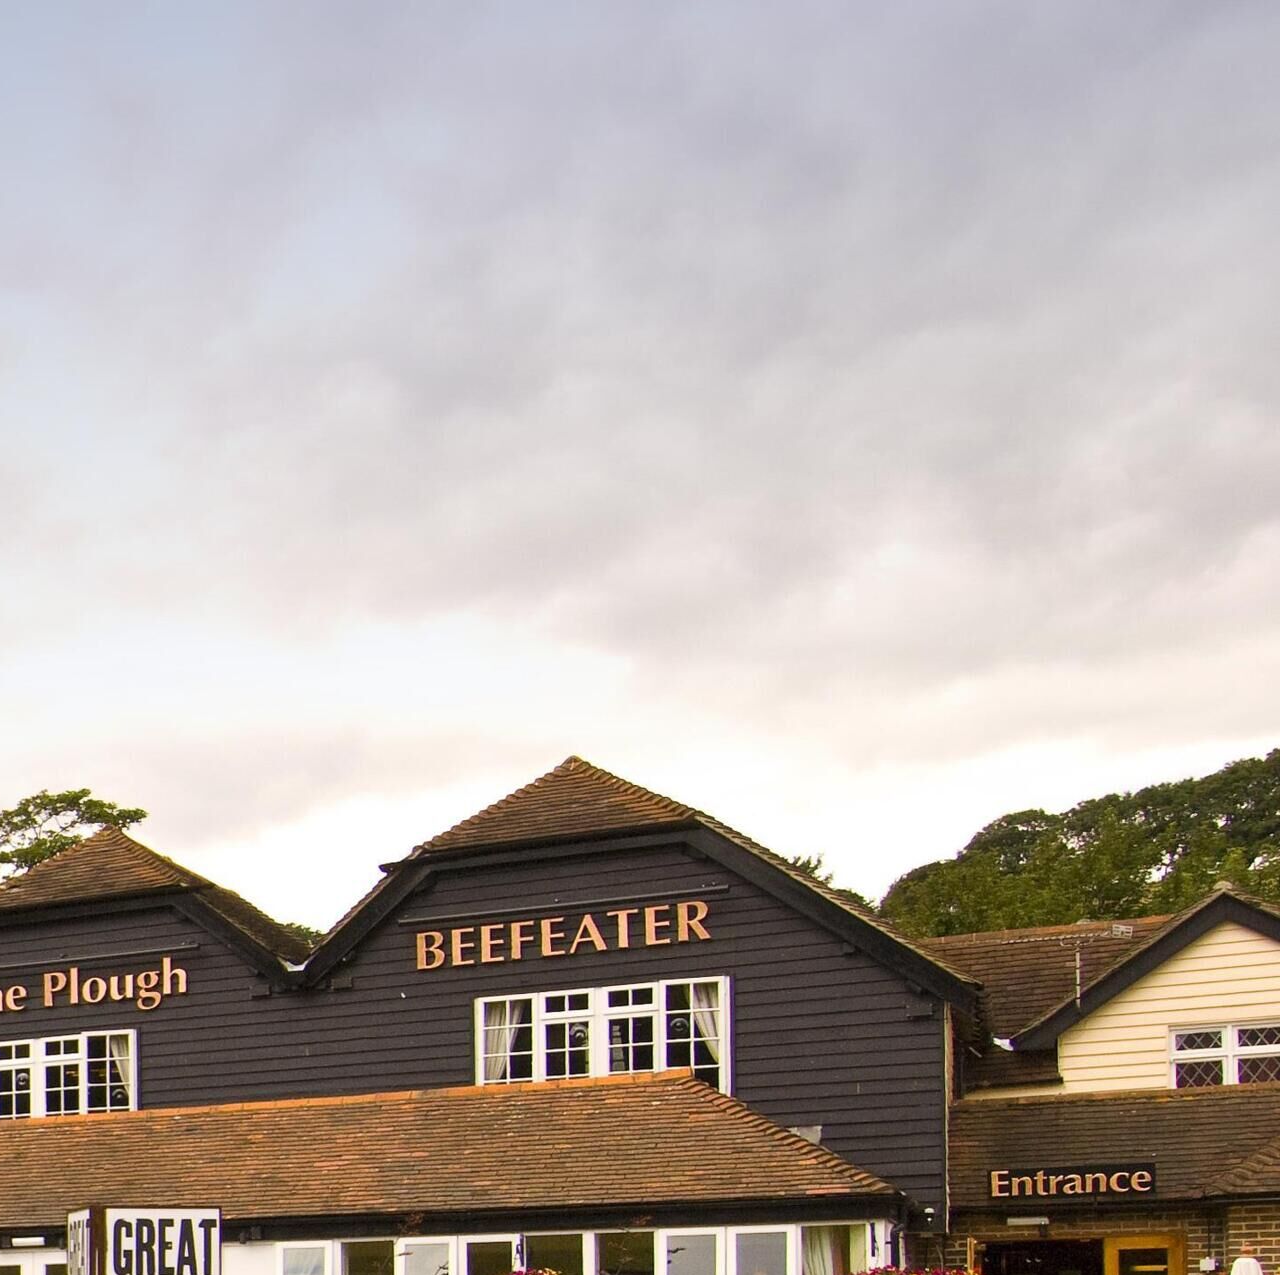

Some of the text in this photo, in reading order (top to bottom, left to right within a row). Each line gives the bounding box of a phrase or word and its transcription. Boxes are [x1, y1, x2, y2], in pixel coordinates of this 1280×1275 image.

[415, 900, 711, 970] BEEFEATER
[42, 956, 188, 1011] Plough
[990, 1169, 1153, 1198] Entrance
